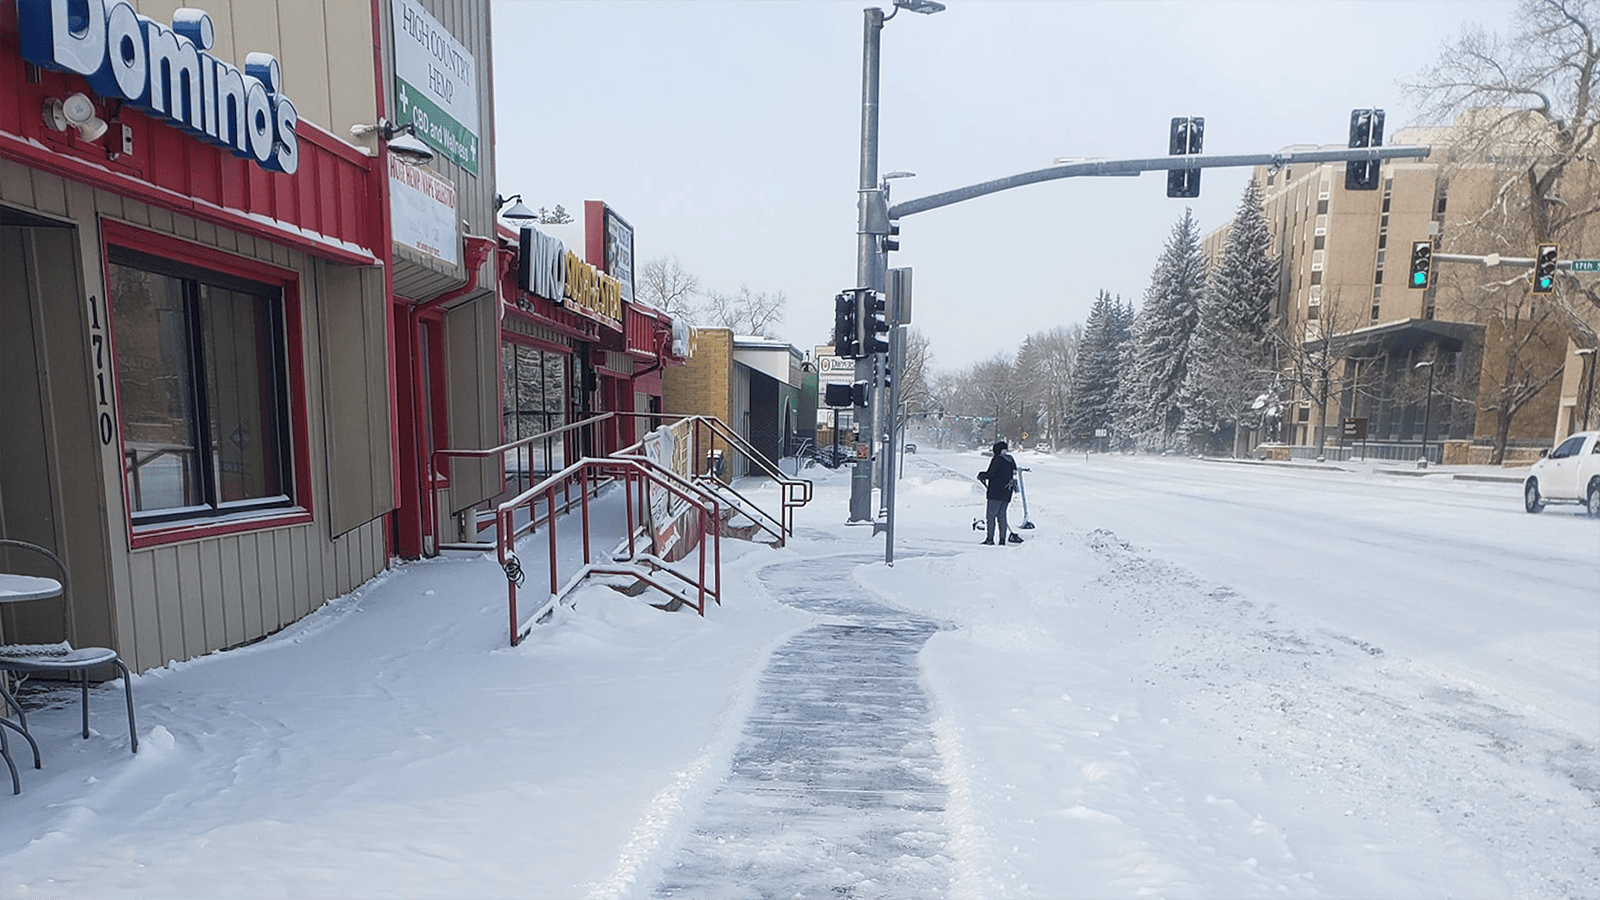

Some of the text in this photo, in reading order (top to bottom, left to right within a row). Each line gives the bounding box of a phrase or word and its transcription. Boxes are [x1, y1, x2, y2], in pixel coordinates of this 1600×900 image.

[402, 2, 471, 86] HIGH COUNTRY
[428, 62, 454, 105] HEMP
[50, 0, 299, 175] Domino's
[413, 105, 429, 134] CBD
[430, 122, 443, 145] and
[89, 295, 113, 446] 1710
